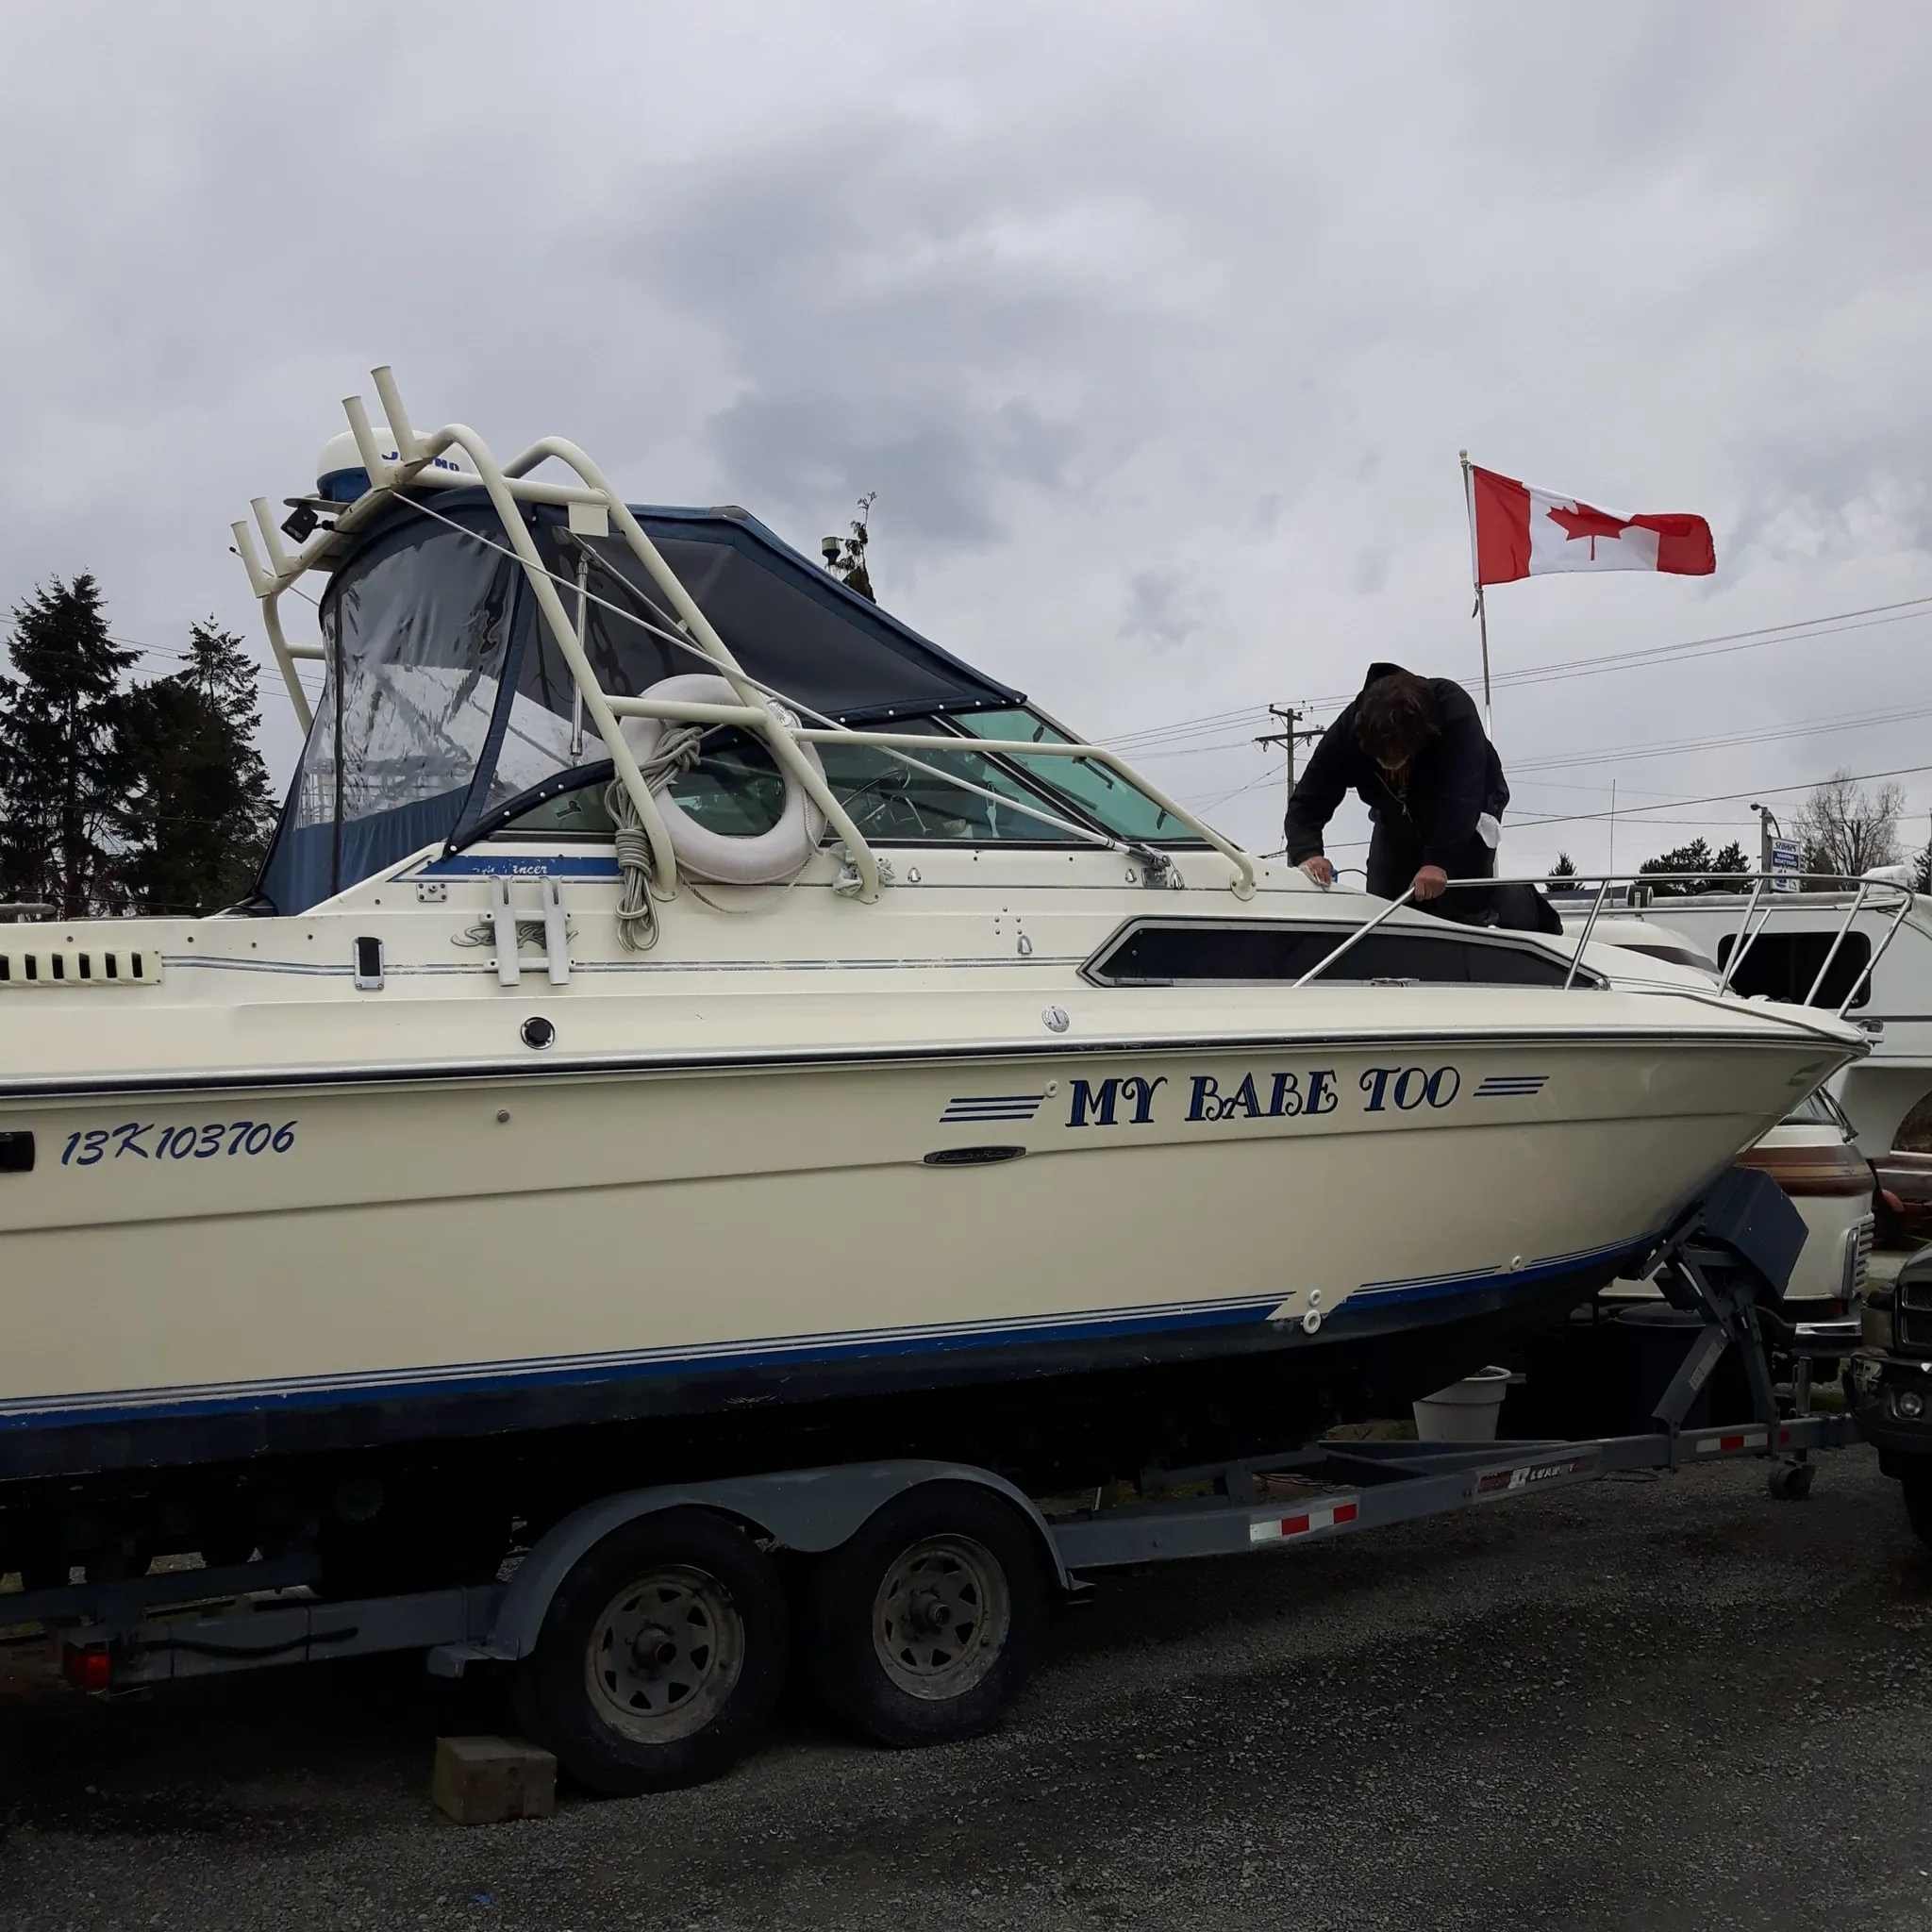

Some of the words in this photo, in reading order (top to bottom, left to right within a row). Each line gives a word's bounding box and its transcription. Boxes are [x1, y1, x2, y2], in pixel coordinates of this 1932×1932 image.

[1065, 1076, 1168, 1127] MY
[1184, 1069, 1339, 1122] BABE
[1358, 1066, 1460, 1112] TOO
[61, 1121, 298, 1166] 13K103706
